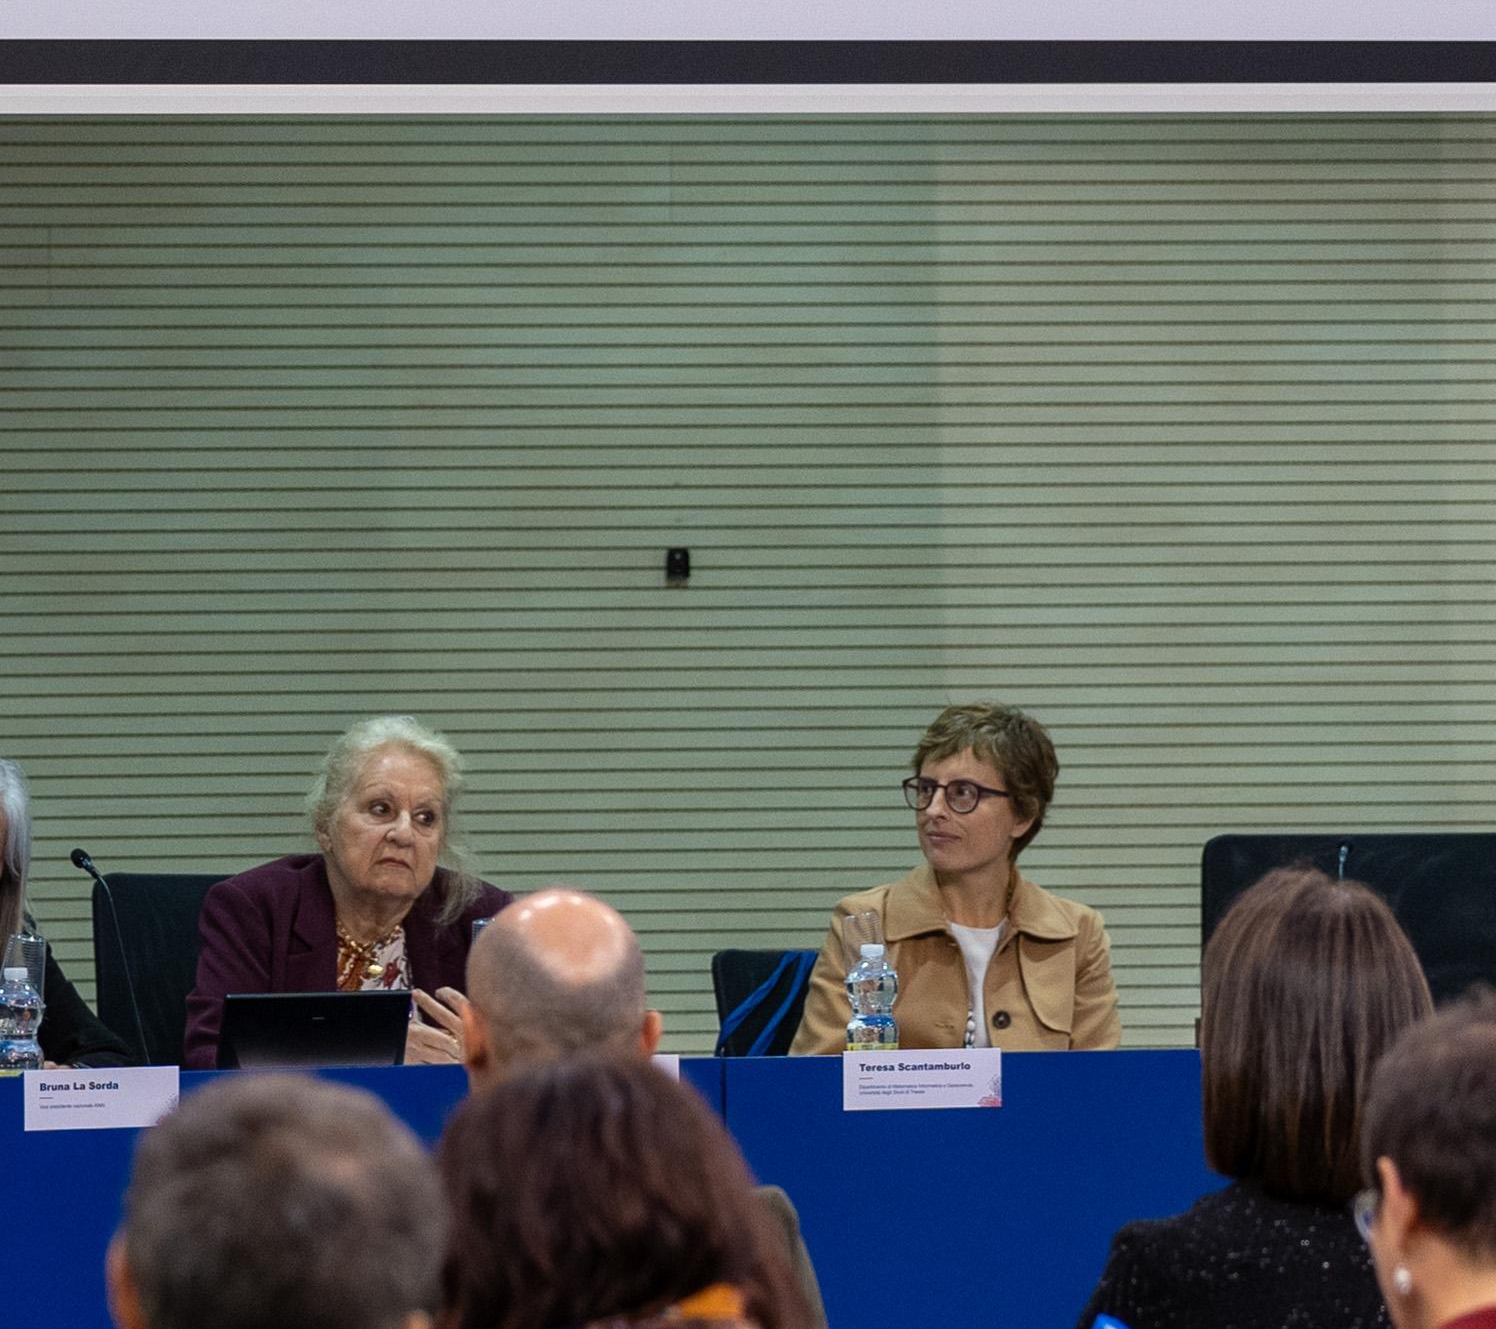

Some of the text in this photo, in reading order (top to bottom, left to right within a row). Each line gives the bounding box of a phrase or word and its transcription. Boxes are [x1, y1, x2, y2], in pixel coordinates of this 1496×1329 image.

[859, 1062, 971, 1072] Teresa Scantamburlo
[40, 1081, 118, 1091] Bruna La Sorda
